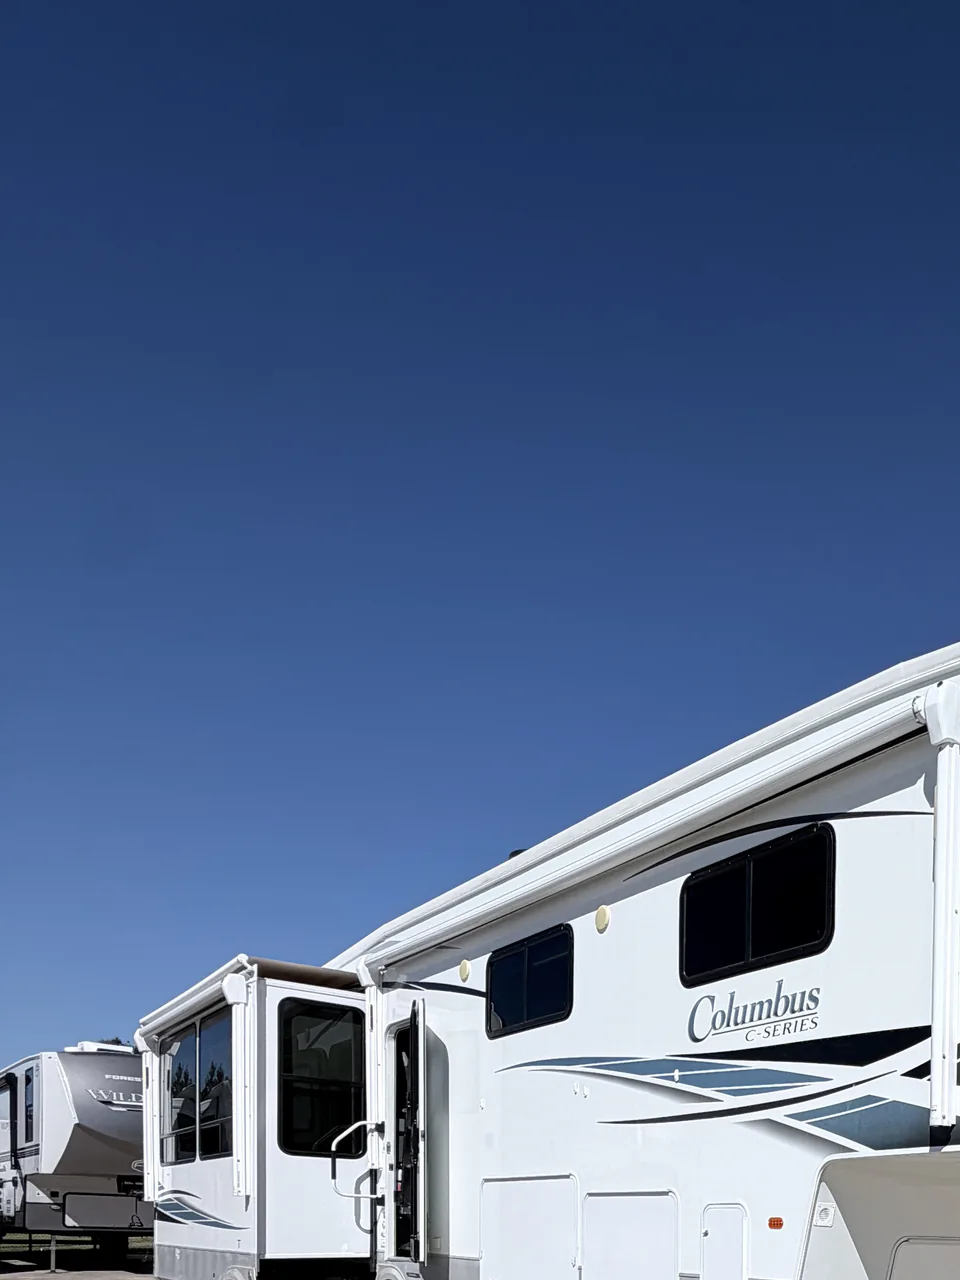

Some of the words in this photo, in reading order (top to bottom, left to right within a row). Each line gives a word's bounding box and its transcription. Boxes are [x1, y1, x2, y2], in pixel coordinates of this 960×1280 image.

[687, 978, 821, 1044] Columbus
[745, 1016, 819, 1042] C-SERIES
[104, 1074, 142, 1082] FORES
